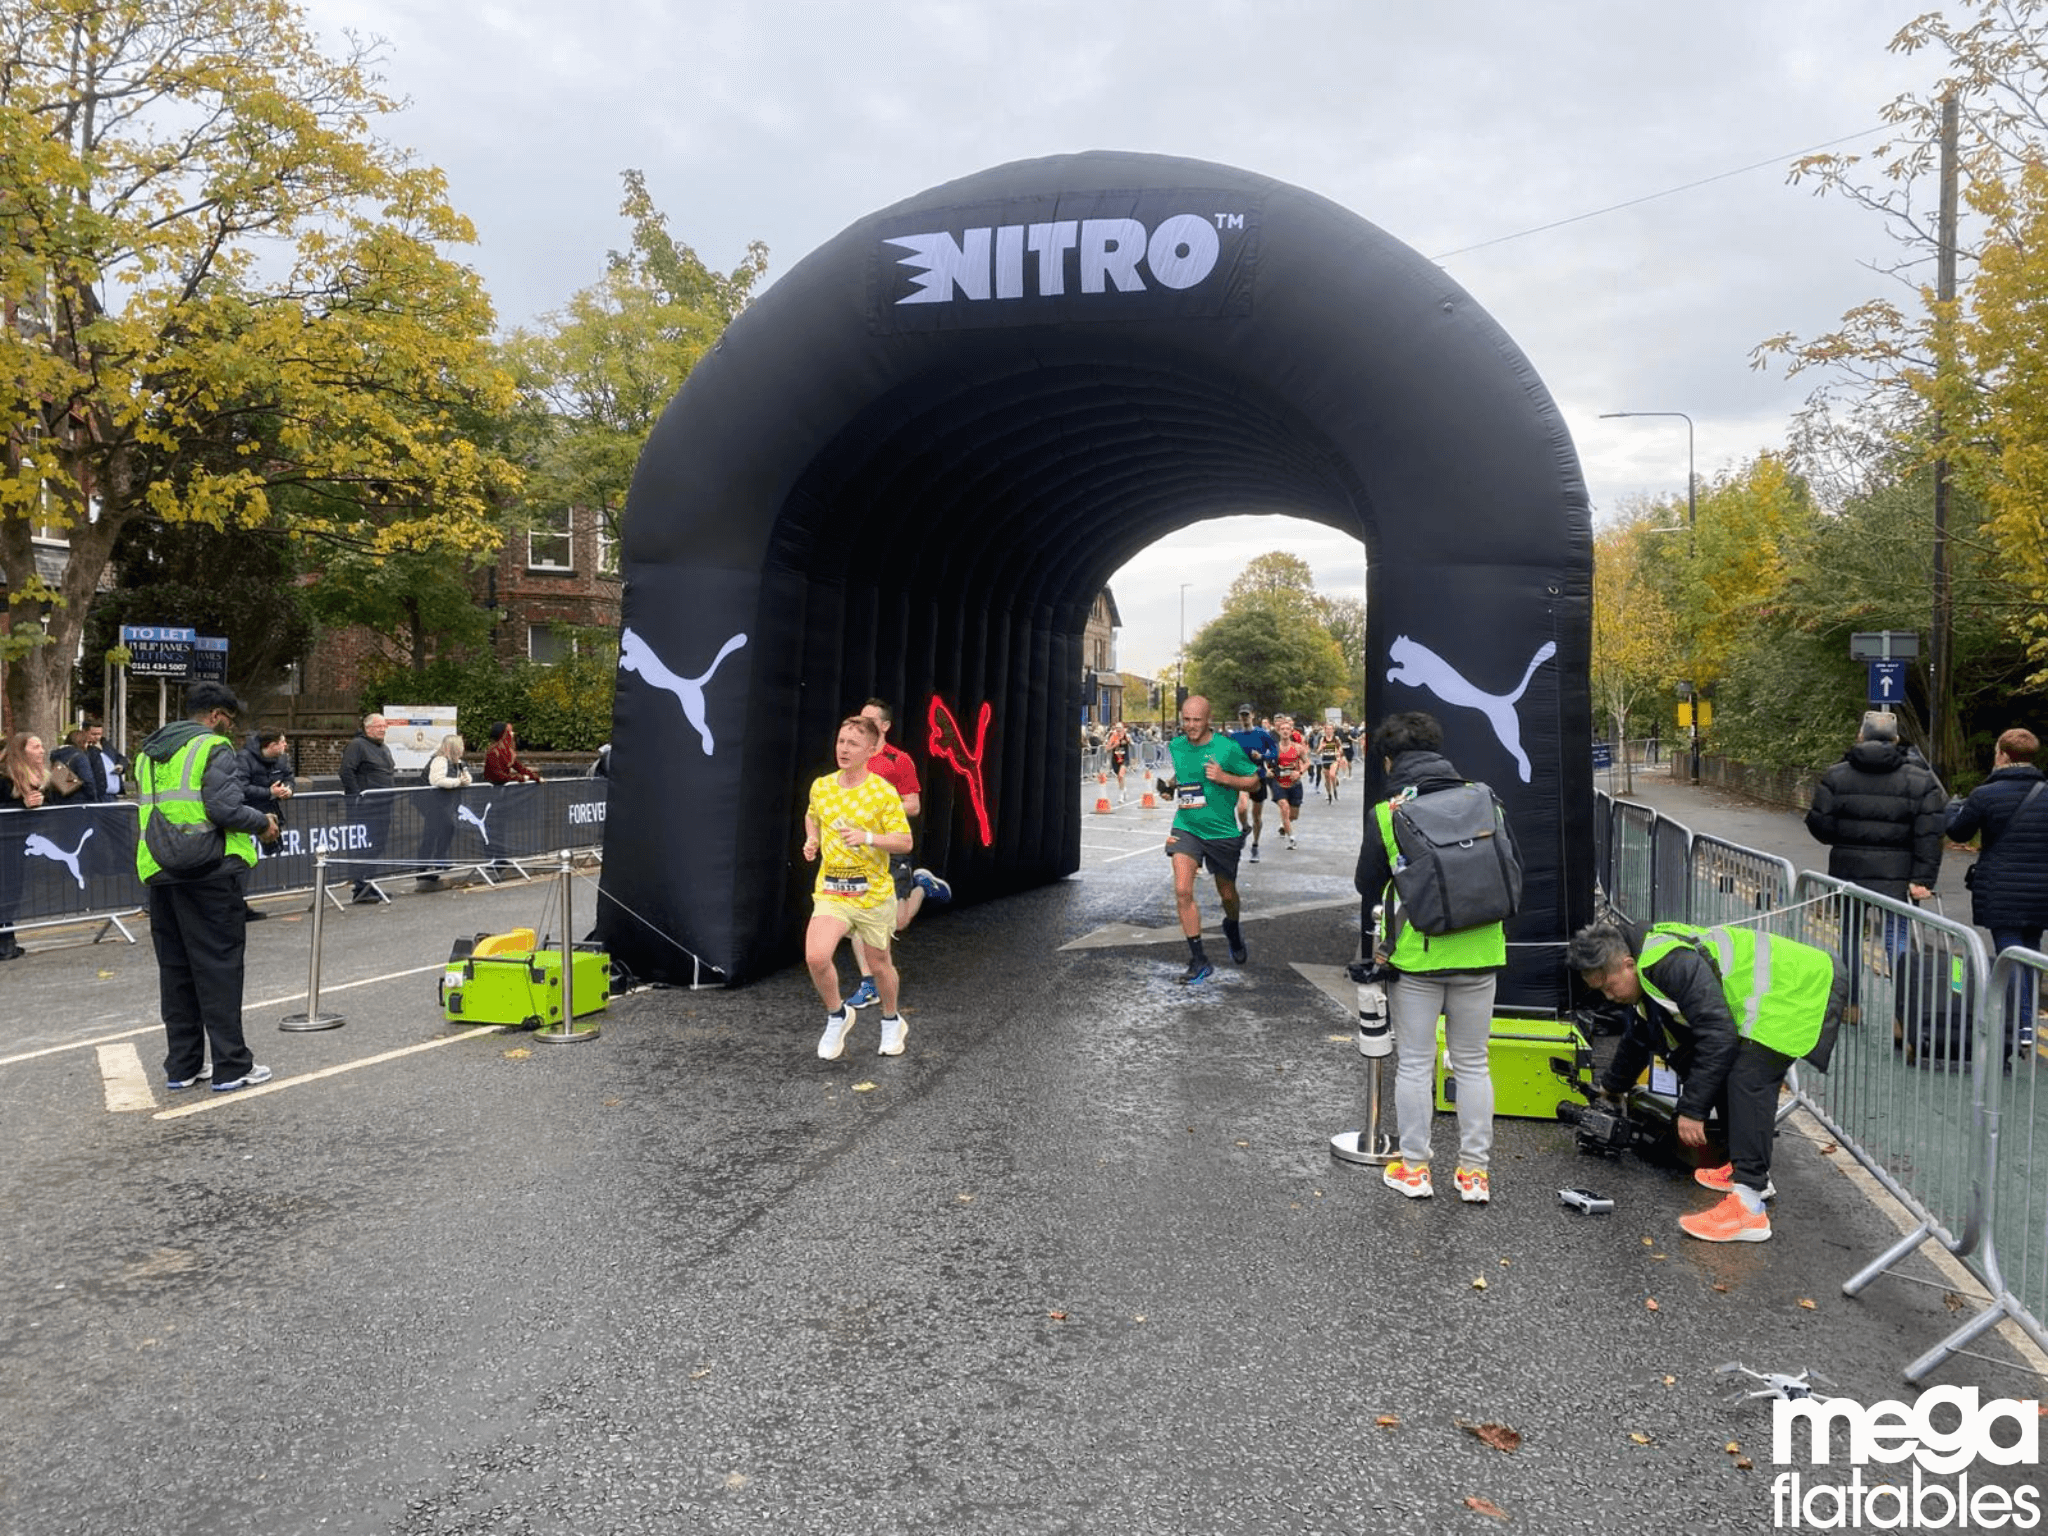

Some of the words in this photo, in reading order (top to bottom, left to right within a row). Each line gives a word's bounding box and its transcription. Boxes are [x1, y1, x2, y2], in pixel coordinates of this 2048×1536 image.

[882, 213, 1220, 304] NITRO
[128, 627, 154, 639] TO
[160, 627, 190, 640] LET
[160, 642, 190, 652] JAMES
[131, 662, 151, 670] 0161
[152, 663, 167, 671] 434
[309, 823, 372, 854] FASTER.
